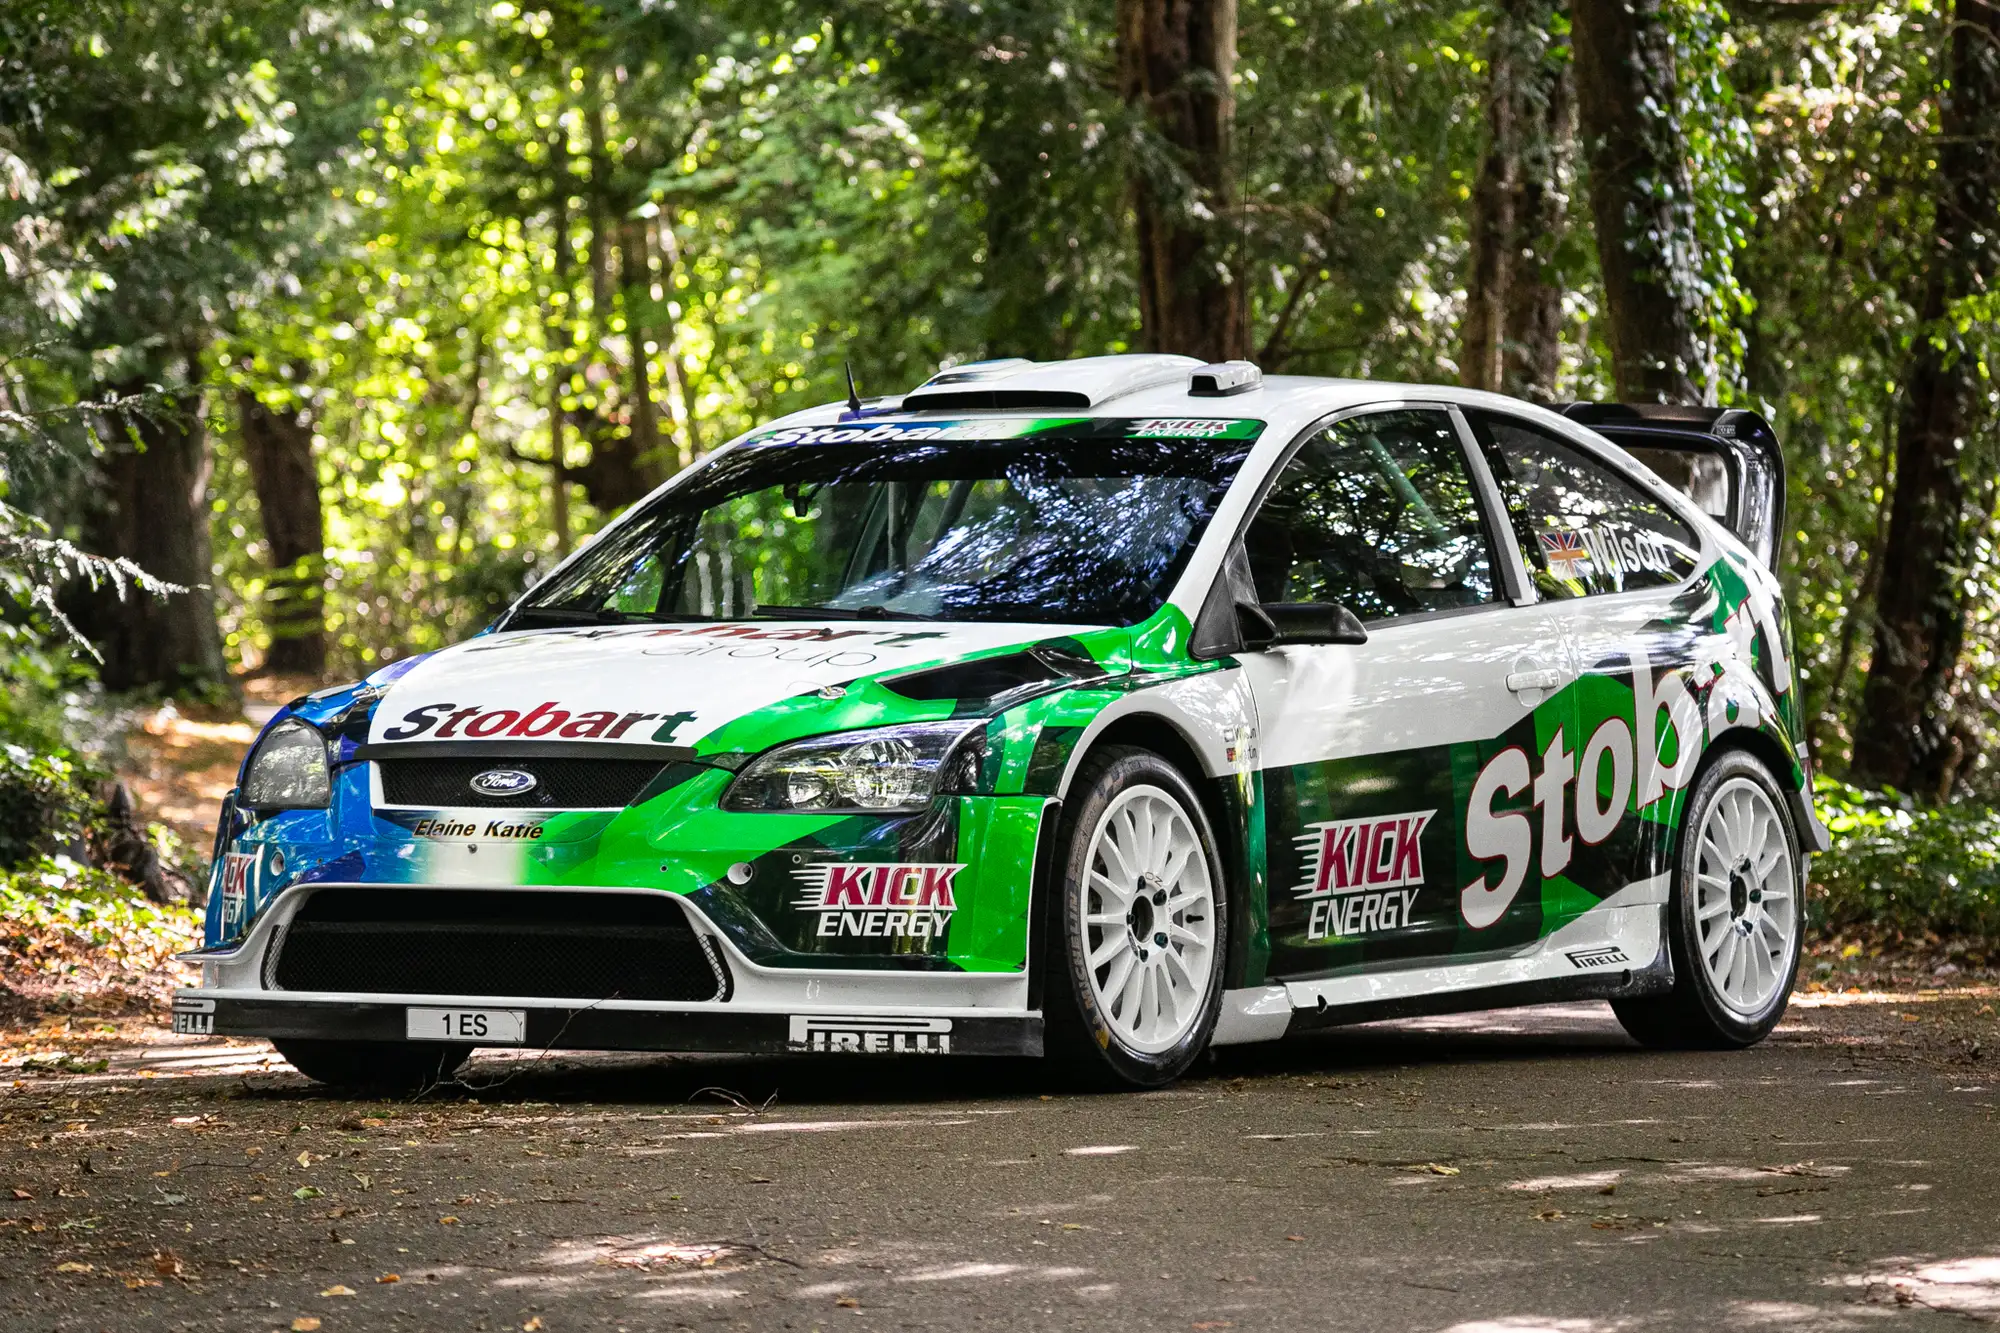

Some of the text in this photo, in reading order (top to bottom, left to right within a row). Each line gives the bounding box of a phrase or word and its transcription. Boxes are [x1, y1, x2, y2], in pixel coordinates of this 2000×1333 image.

[759, 421, 1006, 447] Stobart
[1135, 429, 1228, 437] ENERGY
[1143, 418, 1238, 431] KICK
[1578, 527, 1671, 575] Wilson
[383, 702, 699, 743] Stobart
[481, 772, 521, 787] Ford
[412, 818, 544, 839] Elaine Katie
[1310, 809, 1437, 896] KICK
[817, 863, 967, 910] KICK
[816, 912, 952, 937] ENERGY
[1308, 889, 1420, 940] ENERGY
[1564, 946, 1630, 968] PIRELLI
[442, 1013, 488, 1036] 1 ES
[789, 1015, 952, 1054] PIRELLI
